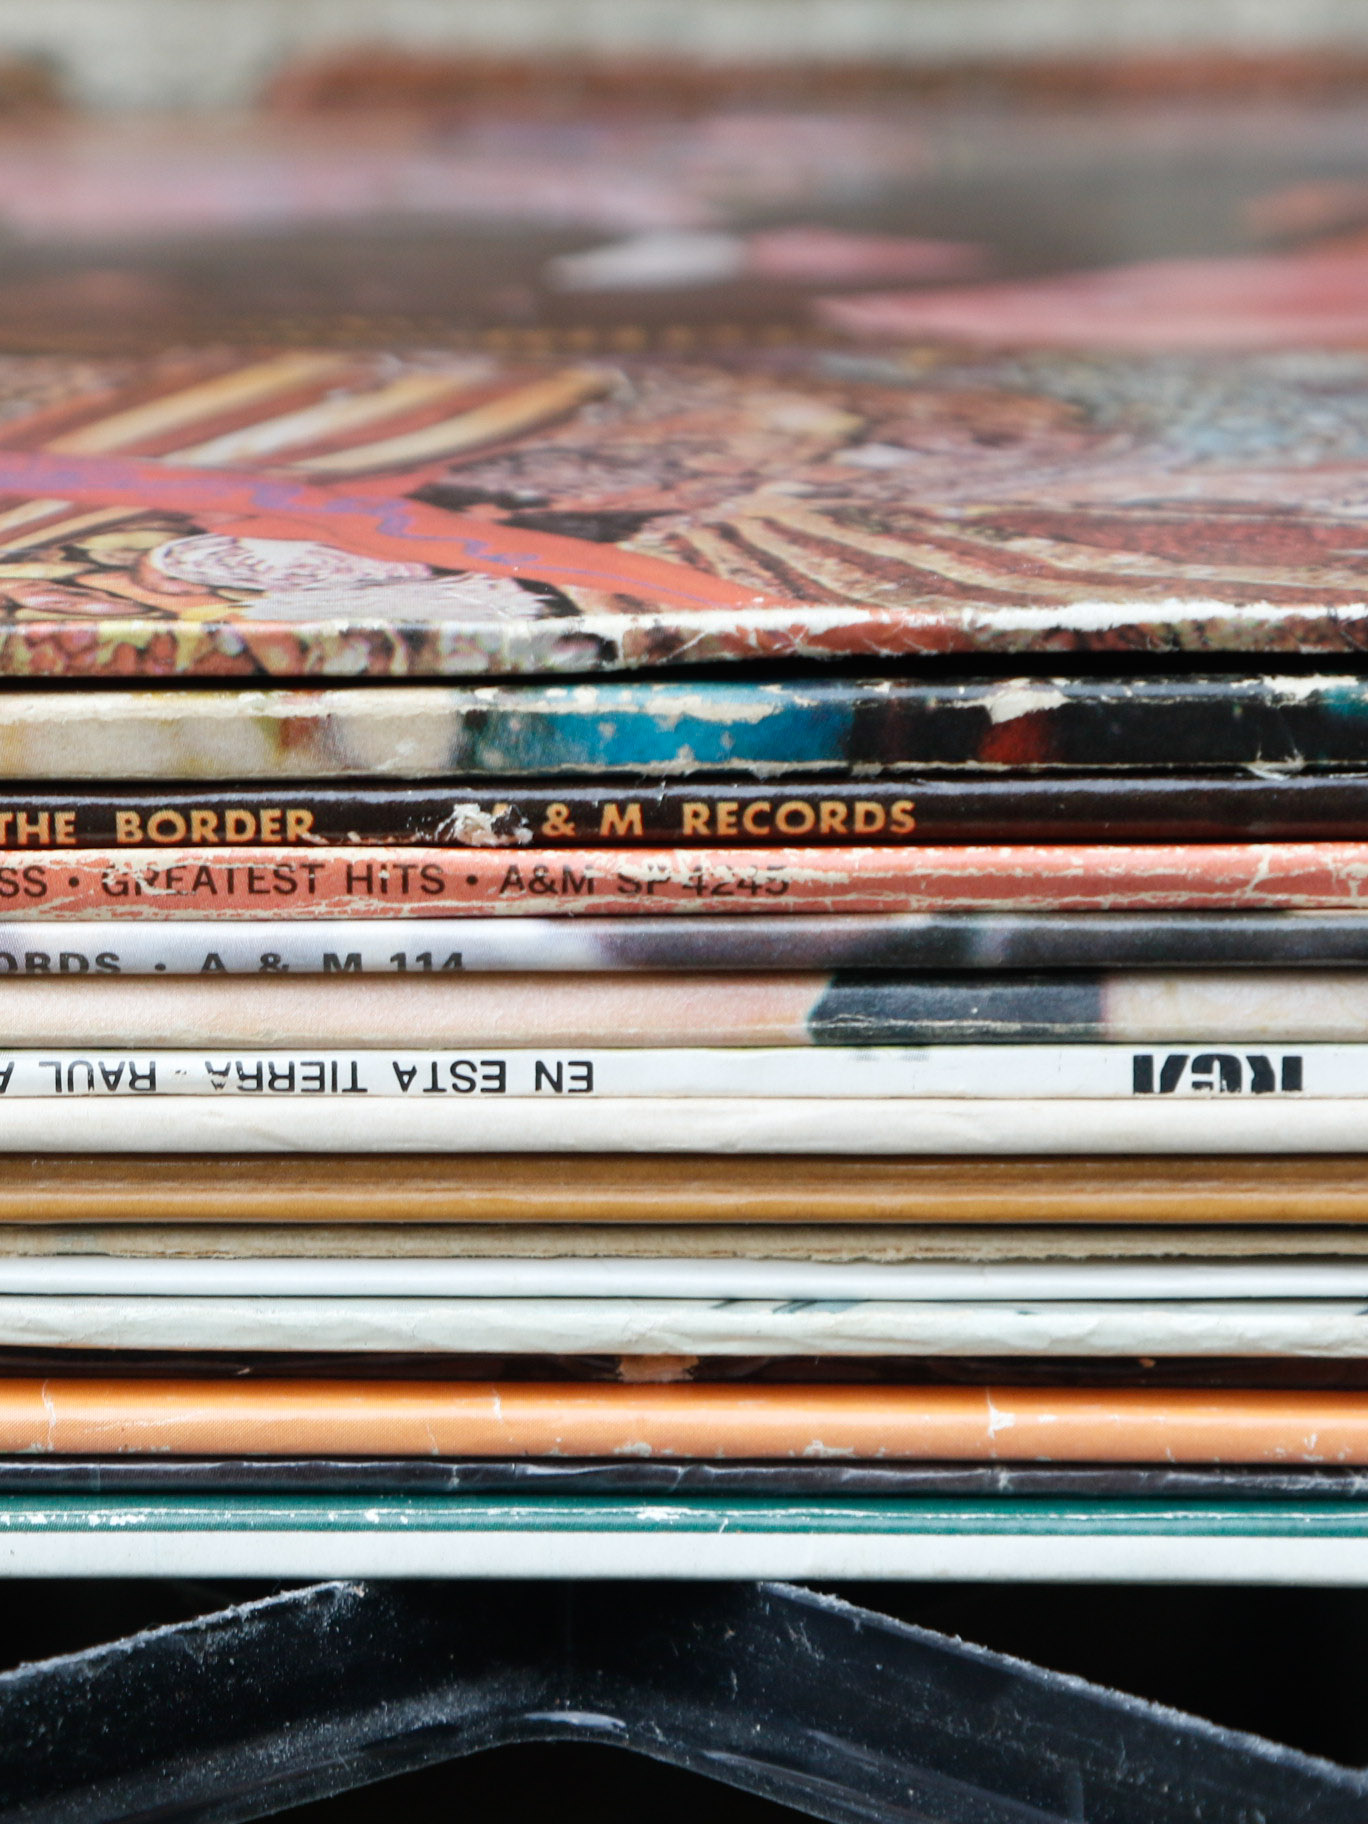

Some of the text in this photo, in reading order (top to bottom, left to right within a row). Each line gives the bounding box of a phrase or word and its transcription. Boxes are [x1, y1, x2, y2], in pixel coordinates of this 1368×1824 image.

[116, 809, 316, 845] BORDER
[541, 803, 575, 838] &
[600, 804, 643, 837] M
[683, 801, 916, 836] RECORDS
[102, 863, 325, 896] GREATEST
[499, 864, 594, 895] A&M
[323, 952, 363, 973] M
[390, 951, 466, 973] 114
[38, 1060, 156, 1093] RAUL
[205, 1060, 368, 1093] TIERRA
[392, 1060, 506, 1093] ESTA
[535, 1060, 594, 1093] EN
[1133, 1054, 1303, 1094] RCA
